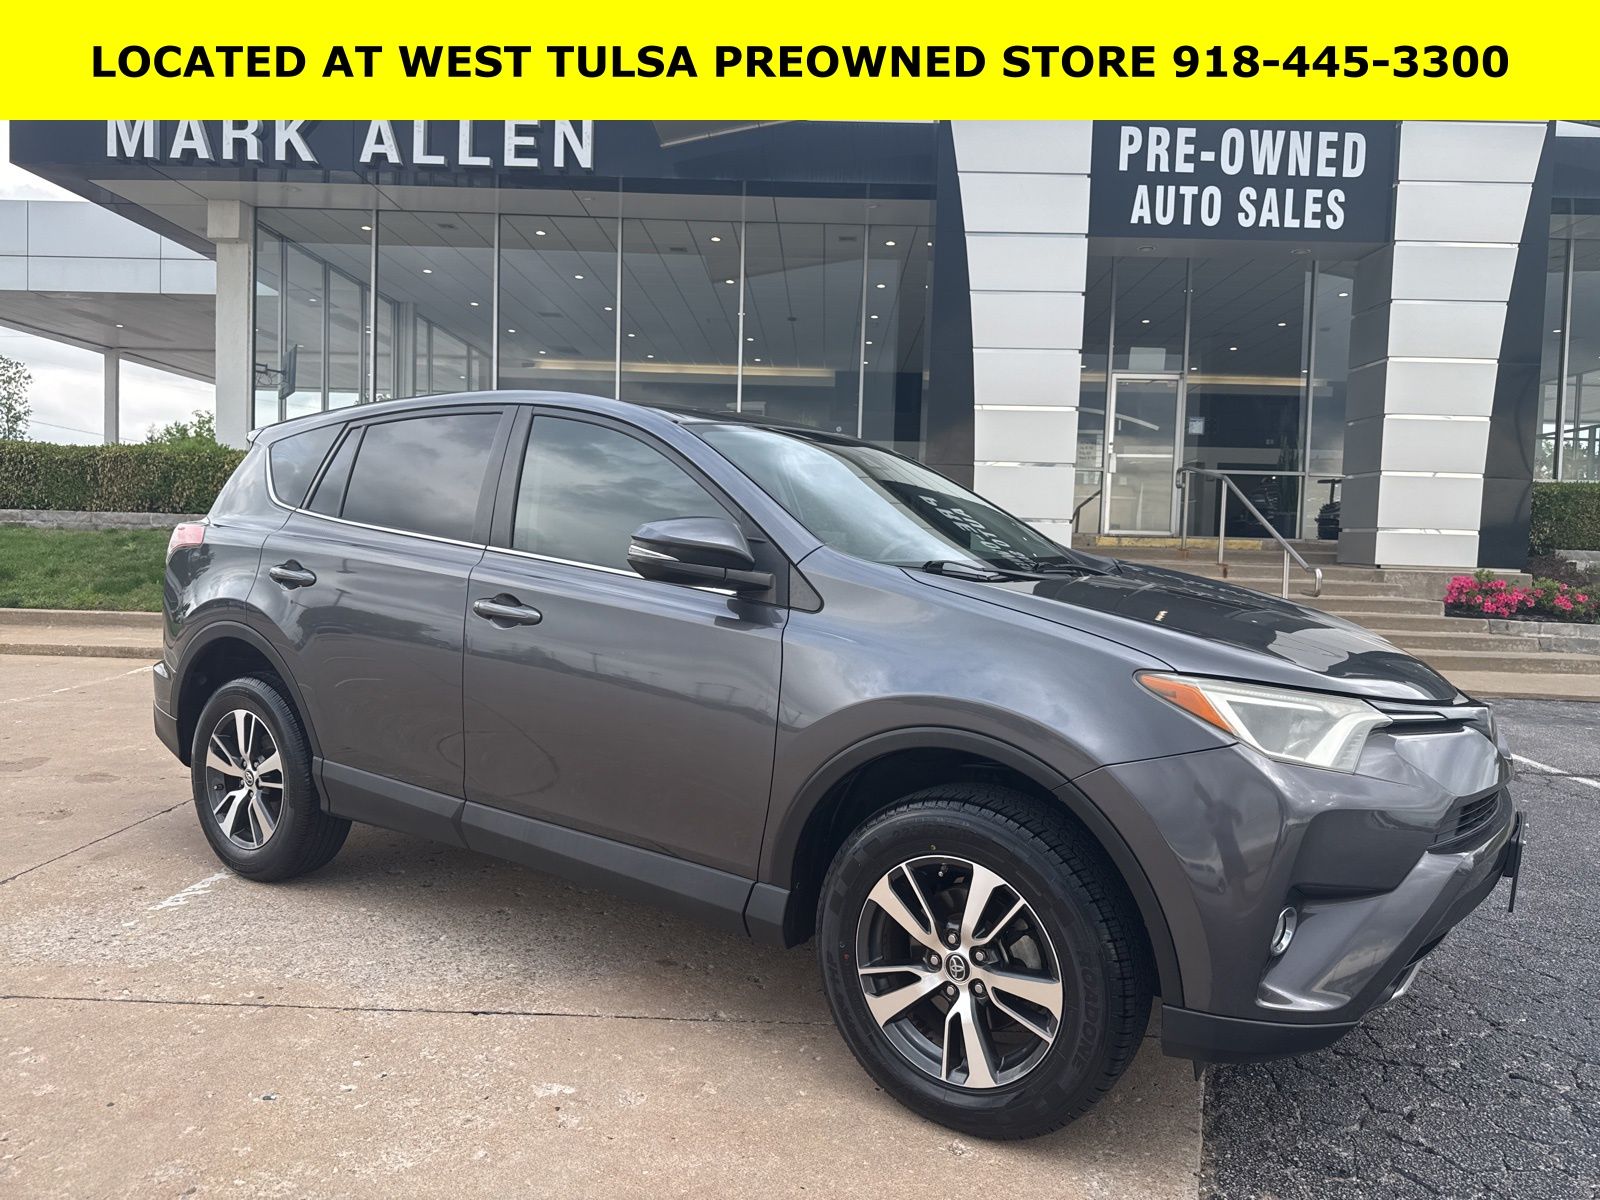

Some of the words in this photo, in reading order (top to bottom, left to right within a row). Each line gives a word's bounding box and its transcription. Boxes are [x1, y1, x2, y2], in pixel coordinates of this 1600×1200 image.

[106, 120, 317, 163] MARK
[359, 120, 594, 169] ALLEN
[1118, 125, 1367, 178] PRE-OWNED
[1130, 184, 1222, 226] AUTO
[1237, 186, 1346, 230] SALES
